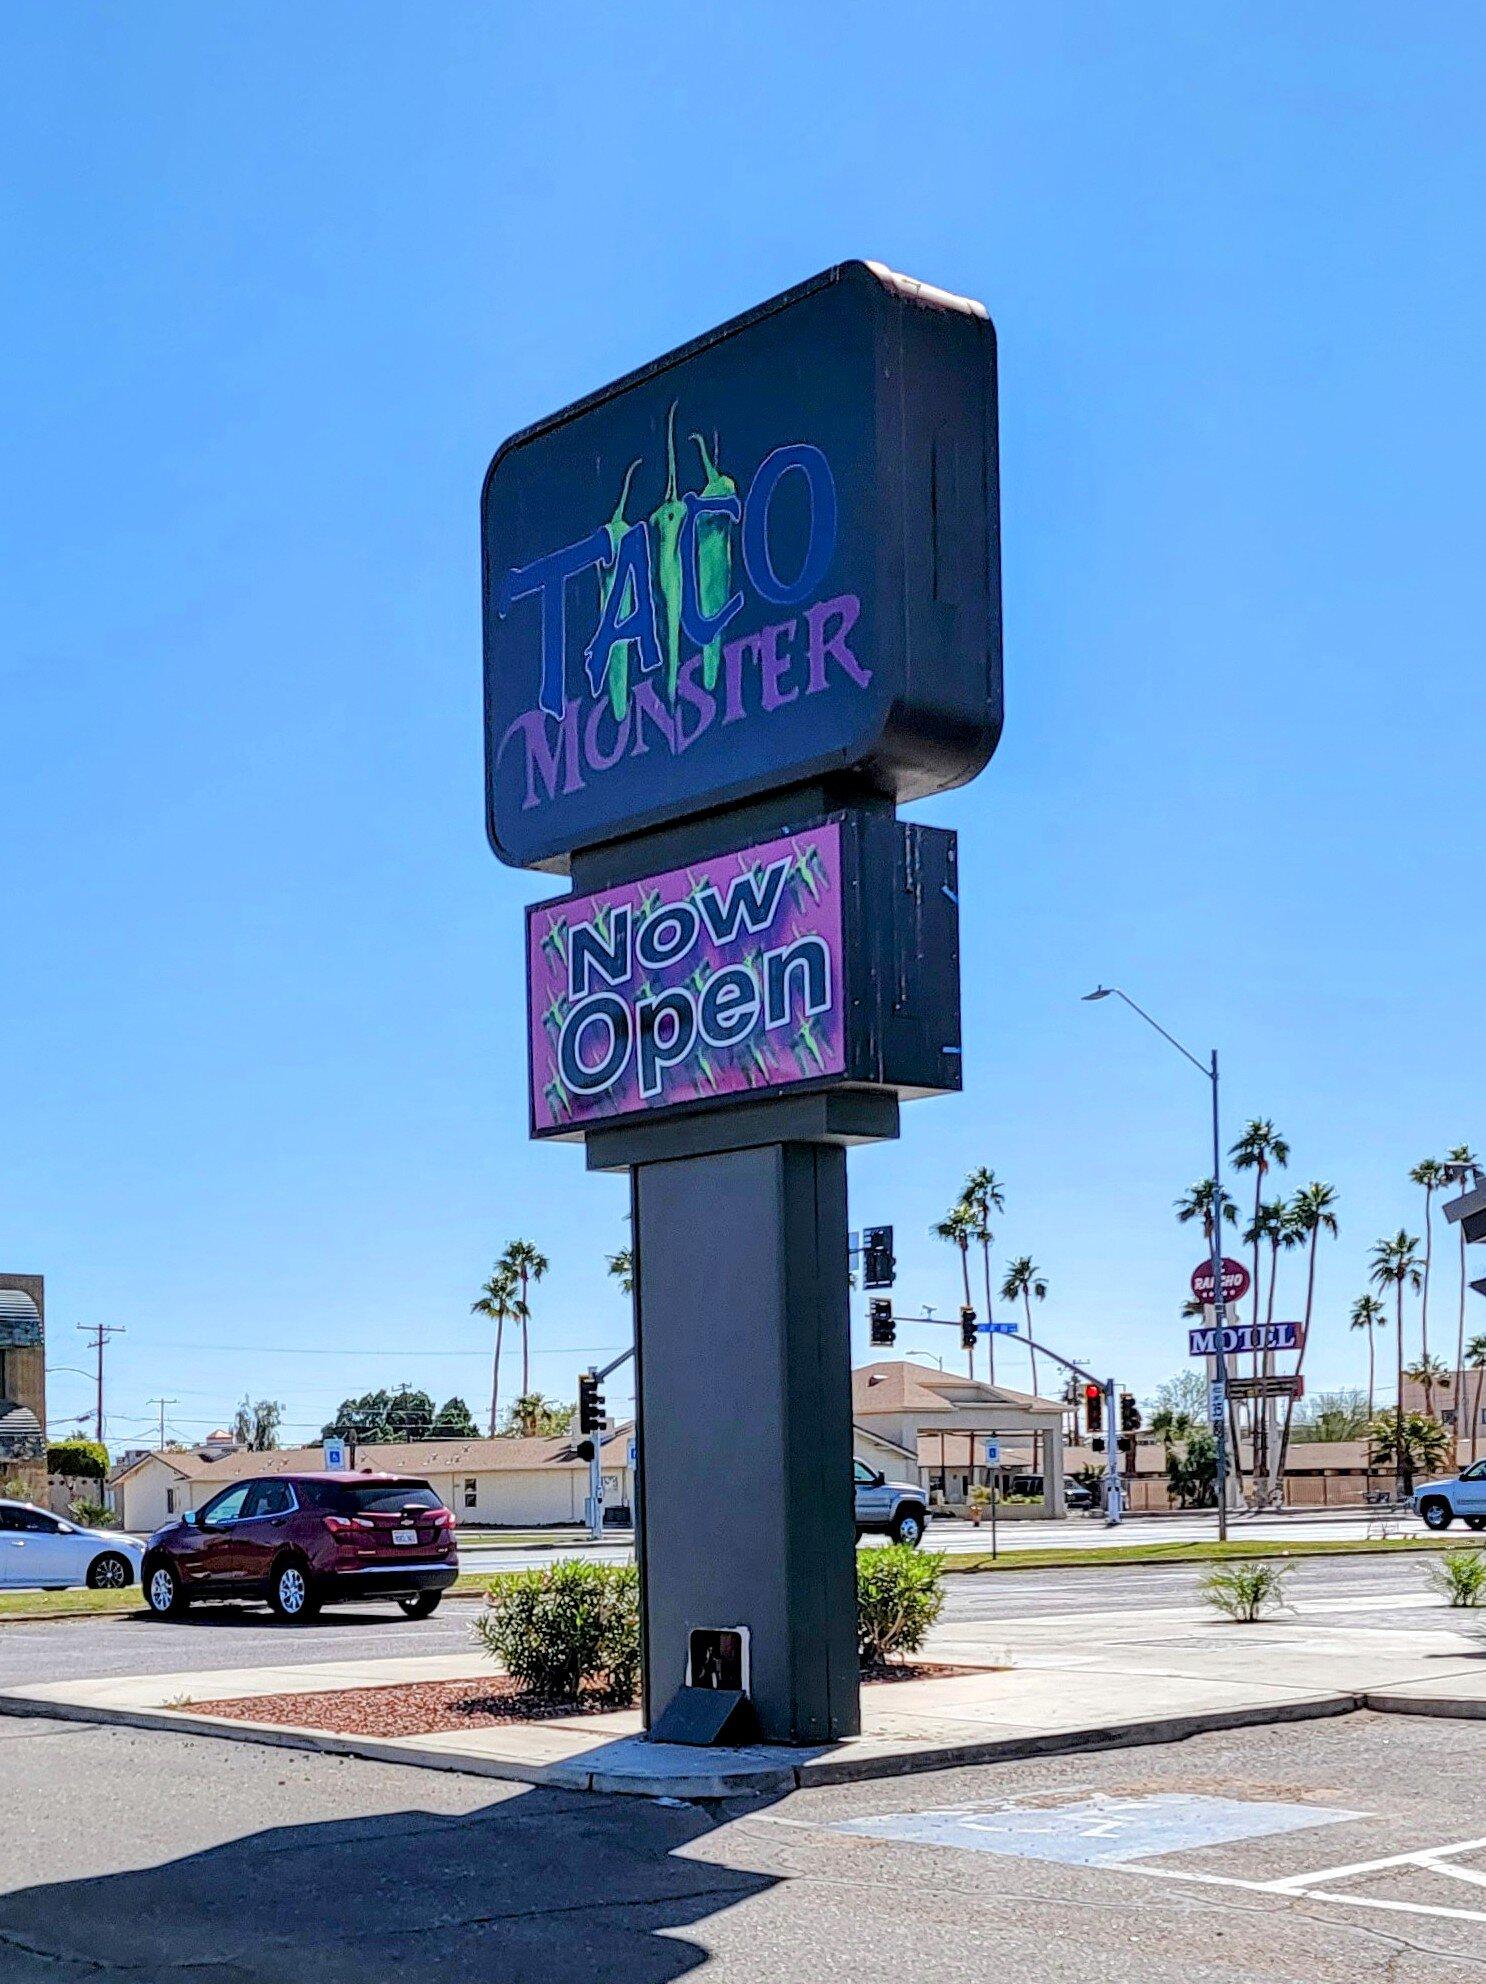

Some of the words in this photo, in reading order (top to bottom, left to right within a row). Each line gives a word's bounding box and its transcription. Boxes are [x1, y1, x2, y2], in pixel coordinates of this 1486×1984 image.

[499, 443, 837, 721] TACO
[497, 594, 873, 811] MONSTER
[568, 855, 793, 1001] Now
[558, 935, 831, 1098] Open
[1190, 1325, 1295, 1353] MOTEL
